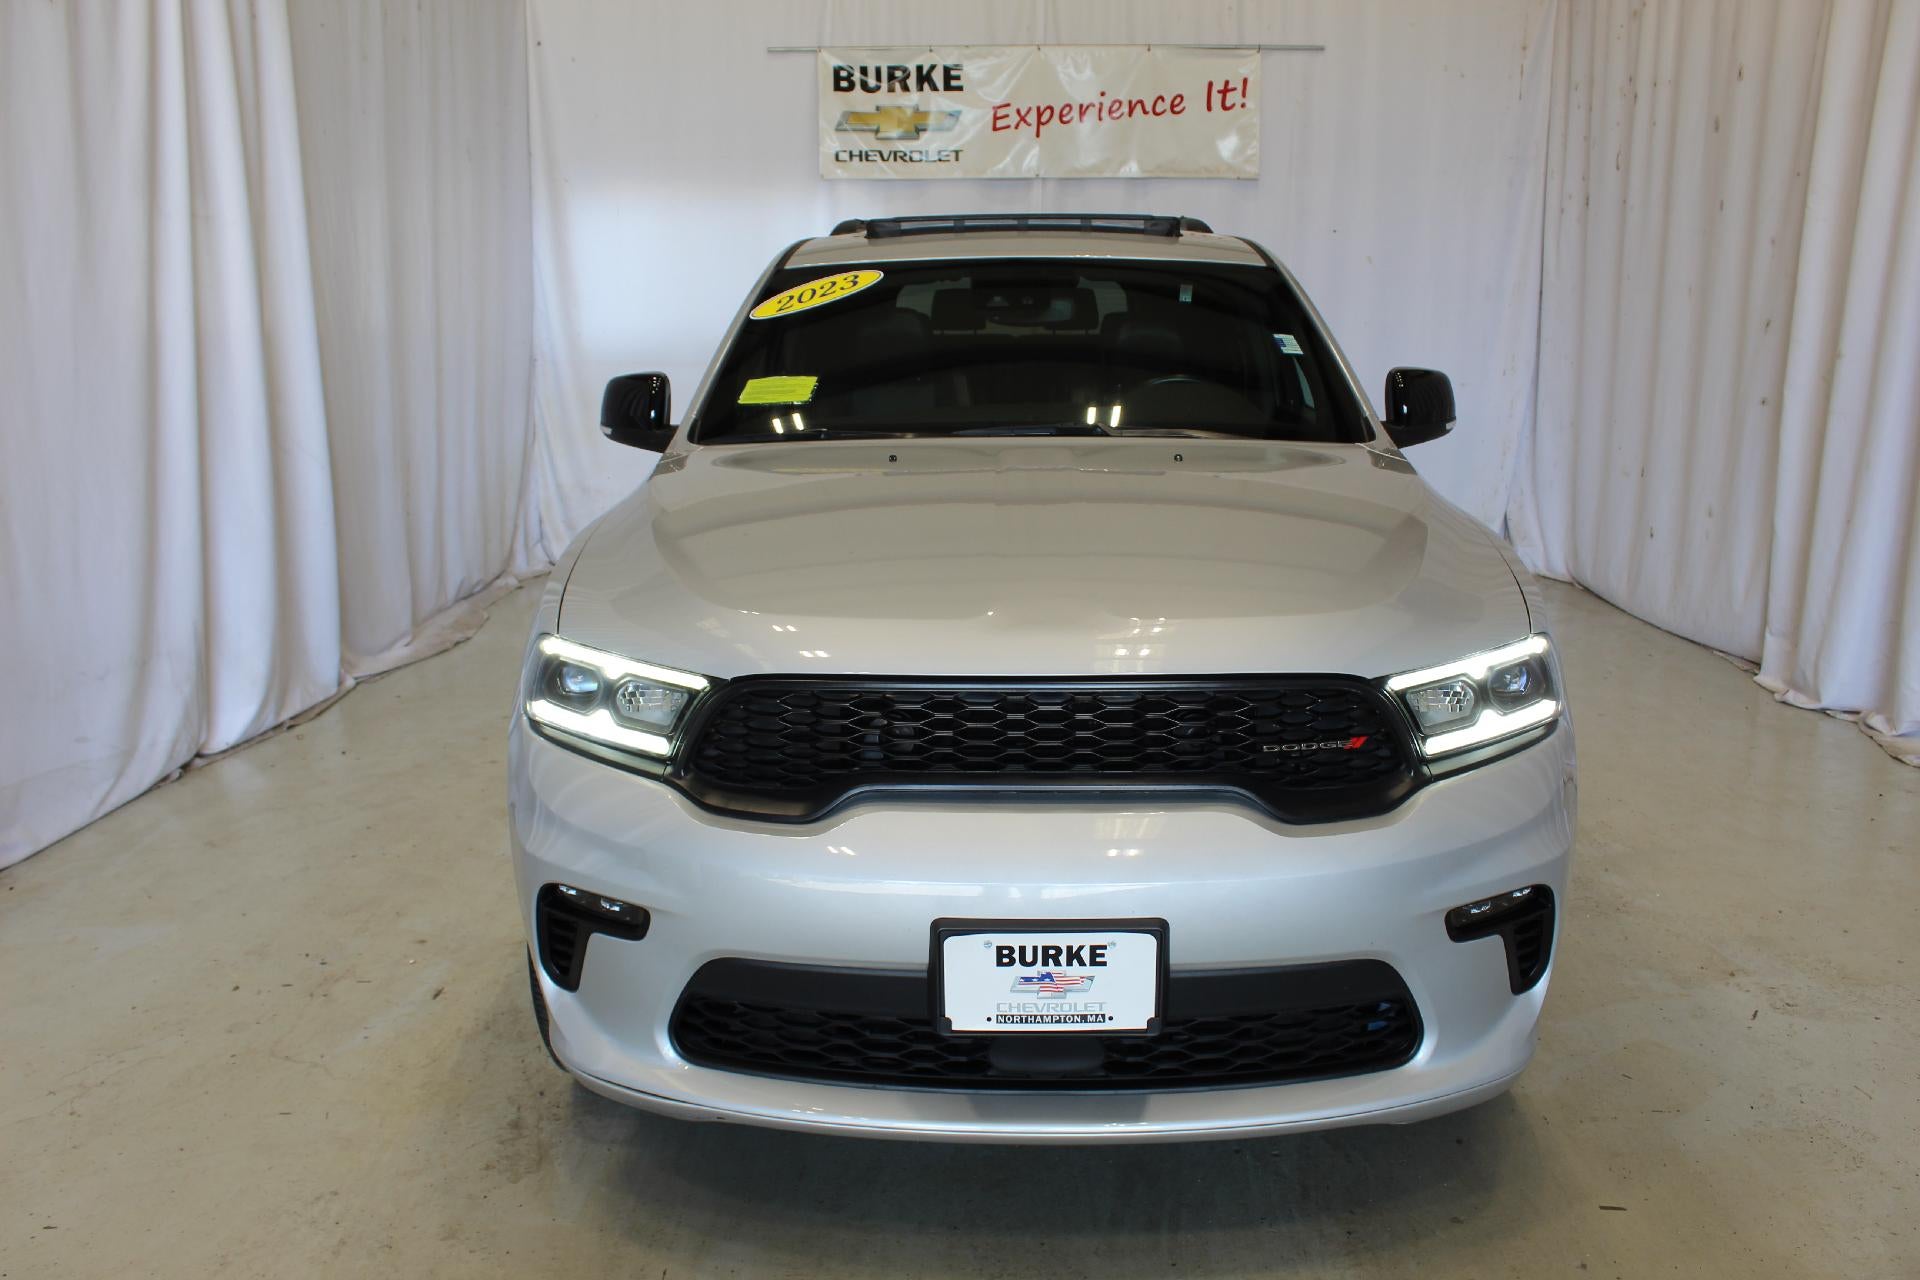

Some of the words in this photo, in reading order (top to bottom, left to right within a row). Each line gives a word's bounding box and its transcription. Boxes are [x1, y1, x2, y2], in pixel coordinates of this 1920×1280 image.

[833, 64, 964, 93] BURKE
[992, 91, 1186, 138] Experience
[1206, 77, 1248, 112] It!
[835, 149, 963, 162] CHEVROLET
[775, 274, 859, 312] 2023
[1263, 740, 1352, 752] DODGE
[996, 945, 1107, 967] BURKE
[996, 1002, 1107, 1013] CHEVROLET
[997, 1015, 1085, 1023] NORTHAMPTON,
[1087, 1014, 1104, 1023] MA
